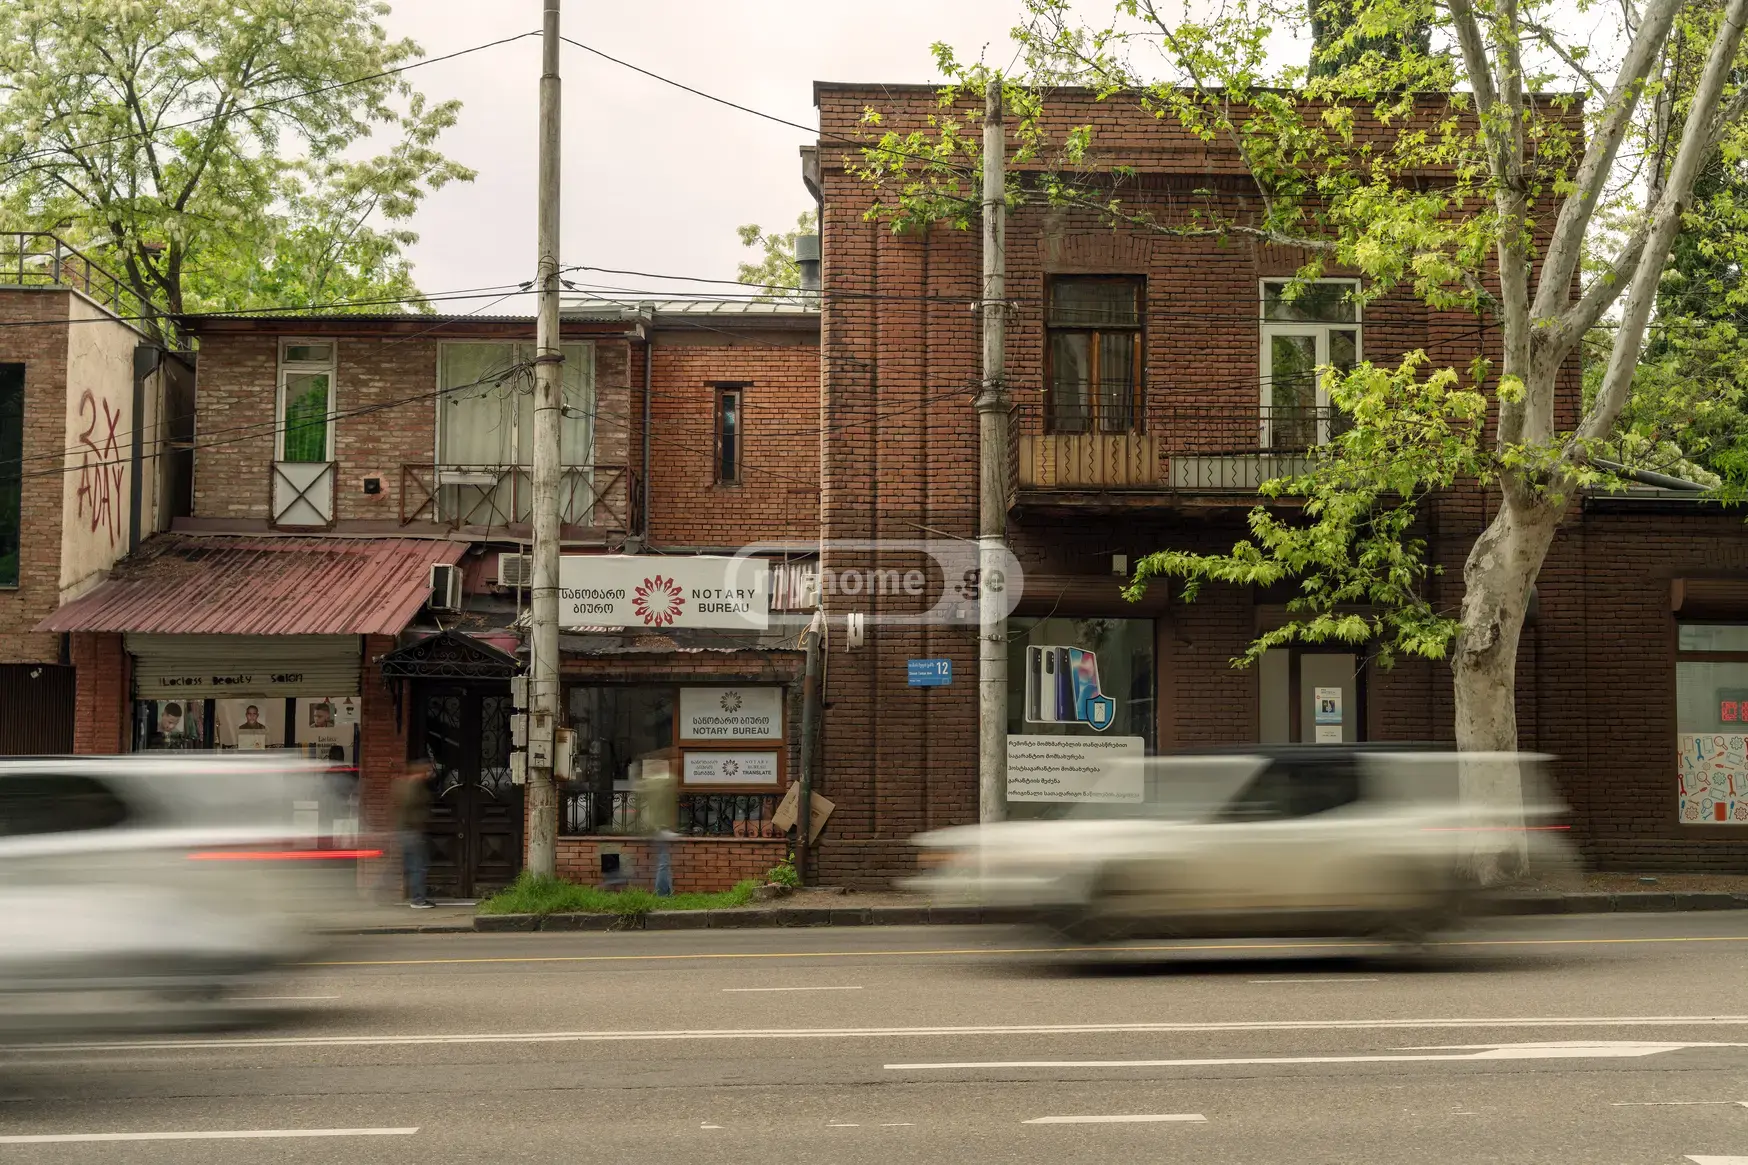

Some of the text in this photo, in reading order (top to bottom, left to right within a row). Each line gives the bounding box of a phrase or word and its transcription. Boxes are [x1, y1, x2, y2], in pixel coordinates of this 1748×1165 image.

[560, 588, 626, 600] სანოტარო
[692, 589, 755, 599] NOTARY
[573, 603, 614, 614] ბიურო
[698, 603, 750, 613] BUREAU
[936, 661, 949, 675] 12
[212, 674, 252, 686] Beauty
[692, 727, 770, 735] NOTARY BUREAU
